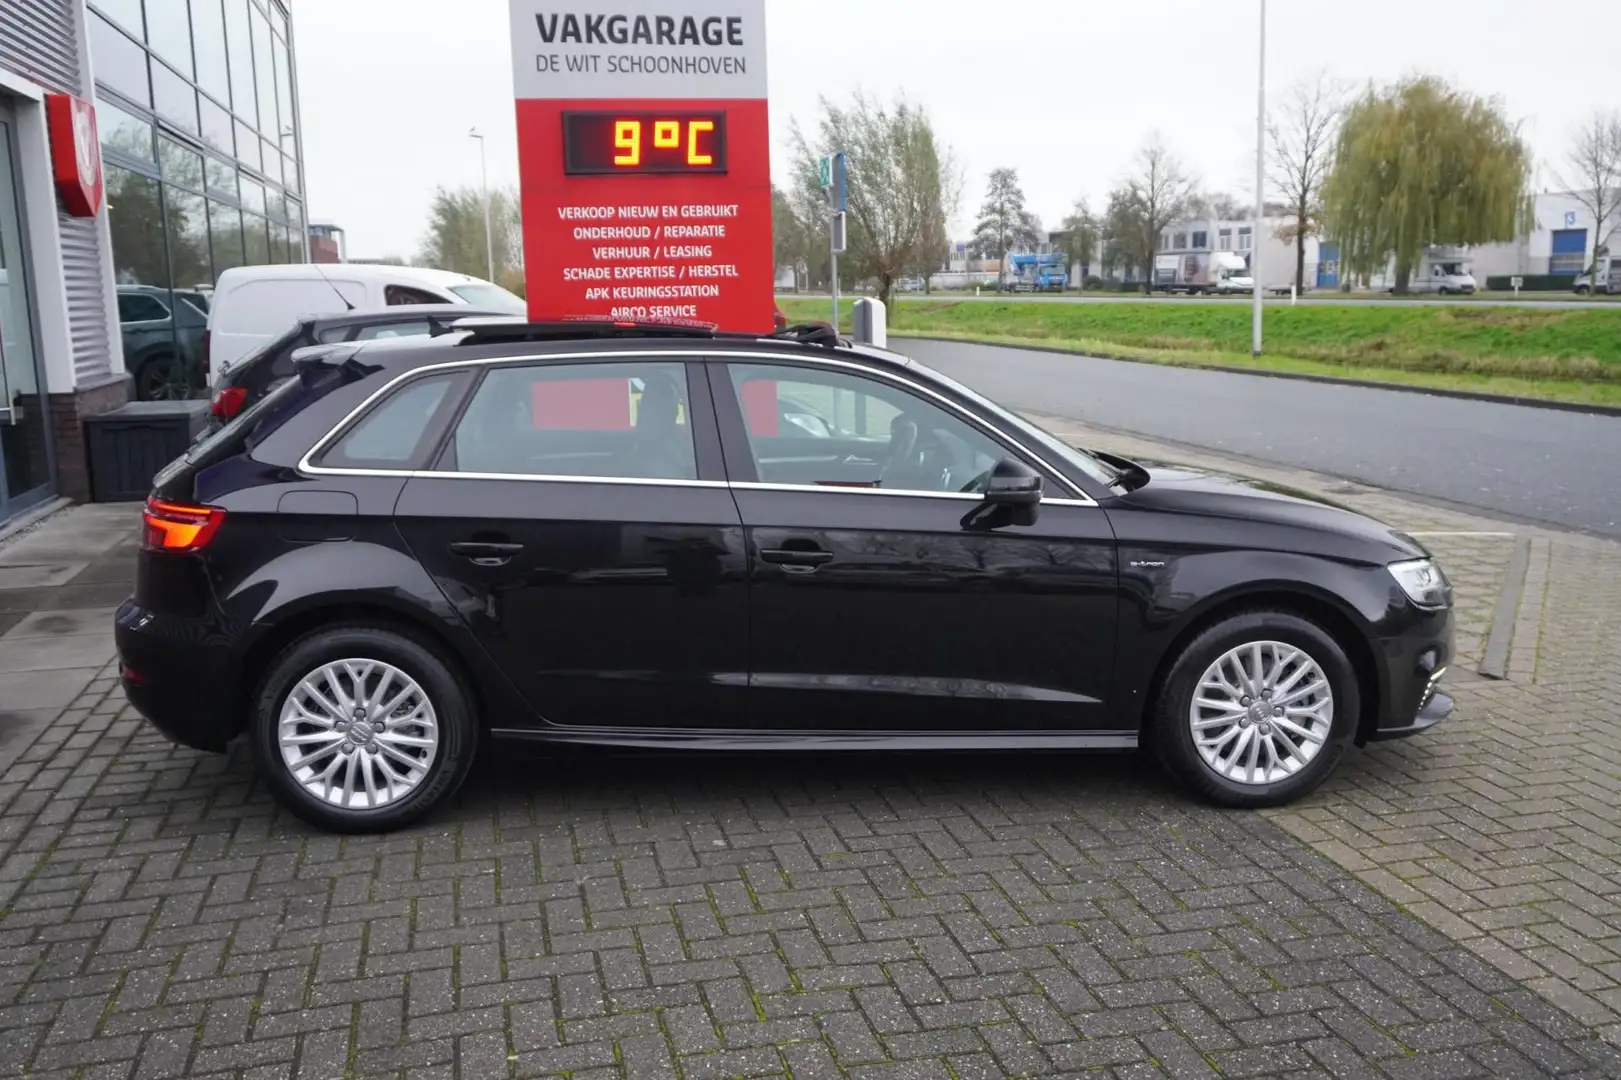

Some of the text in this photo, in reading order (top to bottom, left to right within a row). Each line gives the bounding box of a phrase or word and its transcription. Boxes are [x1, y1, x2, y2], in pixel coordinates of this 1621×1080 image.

[535, 13, 744, 46] VAKGARAGE
[536, 54, 747, 74] DE WIT SCHOONHOVEN
[558, 204, 739, 219] VERKOOP NIEUW EN GEBRUIKT
[573, 225, 725, 239] ONDERHOUD / REPARATIE
[592, 245, 712, 259] VERHUUR / LEASING
[563, 265, 739, 280] SCHADE EXPERTISE / HERSTEL
[585, 285, 719, 300] APK KEURINGSSTATION
[611, 305, 697, 318] AIRCO SERVICE
